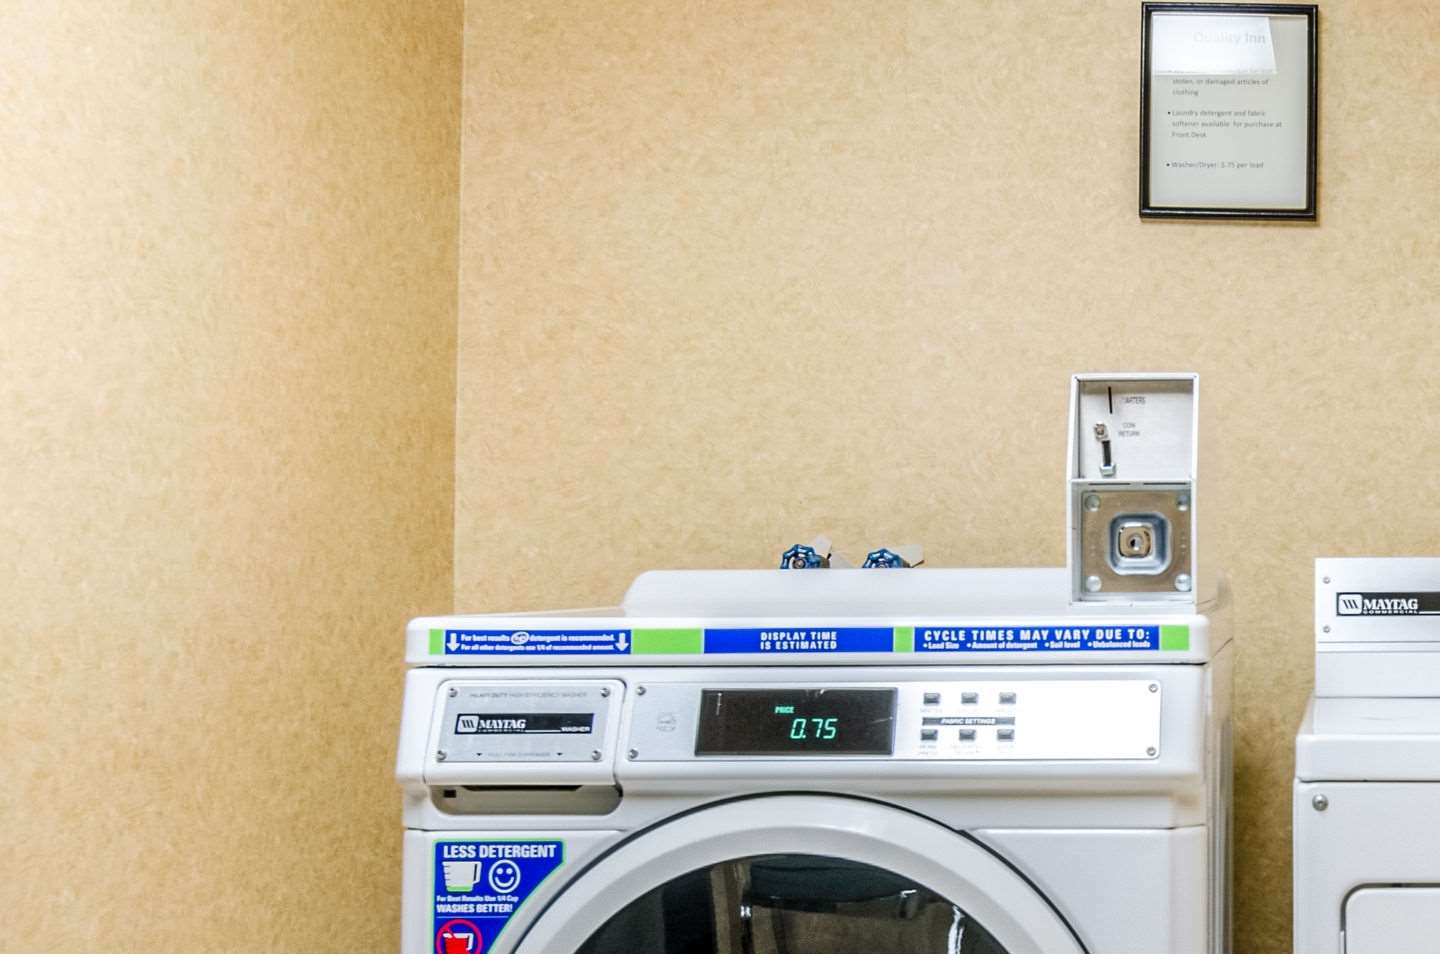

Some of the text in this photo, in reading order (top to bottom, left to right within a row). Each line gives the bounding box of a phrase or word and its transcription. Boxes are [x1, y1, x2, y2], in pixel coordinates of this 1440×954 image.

[1245, 32, 1266, 44] Inn
[1205, 78, 1235, 86] damaged
[1363, 598, 1418, 610] MAYTAG
[530, 634, 560, 643] detergent
[760, 632, 837, 641] DISPLAY TIME
[924, 629, 1150, 641] CYCLE TIMES MAY VARY DUE TO:
[760, 641, 837, 650] IS ESTIMATED
[1006, 642, 1038, 650] detergent
[775, 706, 795, 714] PRICE
[478, 719, 526, 729] MAYTAG
[790, 718, 838, 739] 0.75
[443, 845, 557, 858] LESS DETERGENT
[507, 895, 519, 903] Cup
[436, 904, 513, 913] WASHES BETTER!
